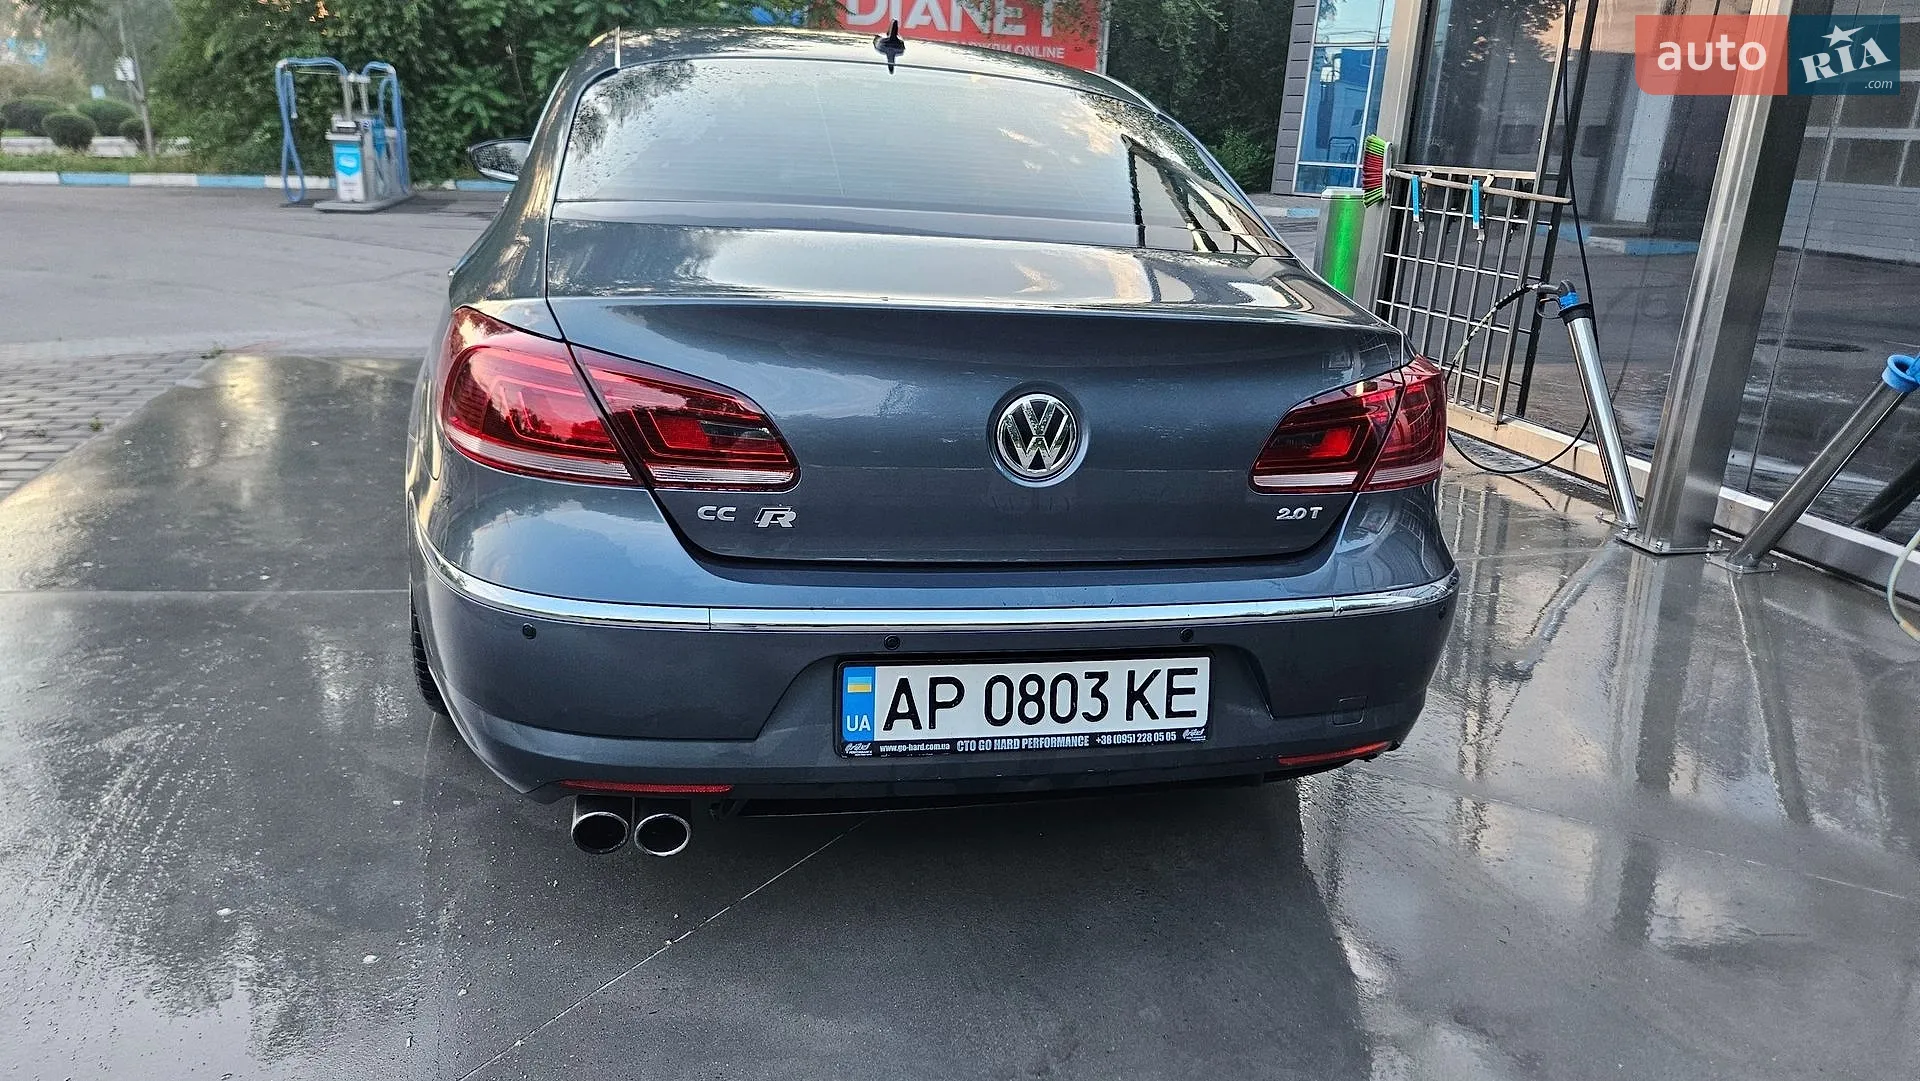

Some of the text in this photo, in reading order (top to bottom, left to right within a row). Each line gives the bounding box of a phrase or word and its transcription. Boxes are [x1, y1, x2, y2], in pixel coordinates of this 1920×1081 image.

[1014, 45, 1065, 59] ONLINE
[697, 505, 797, 528] CC R
[882, 667, 1199, 732] AP 0803 KE
[846, 715, 871, 732] UA
[880, 743, 950, 753] www.go-hard.com.ua
[978, 740, 992, 751] GO
[993, 738, 1020, 750] HARD
[1021, 735, 1090, 749] PERFORMANCE
[1096, 734, 1112, 745] +38
[1113, 733, 1136, 744] (095)
[1137, 732, 1153, 743] 228
[1153, 732, 1165, 742] 05
[1165, 731, 1177, 741] 05
